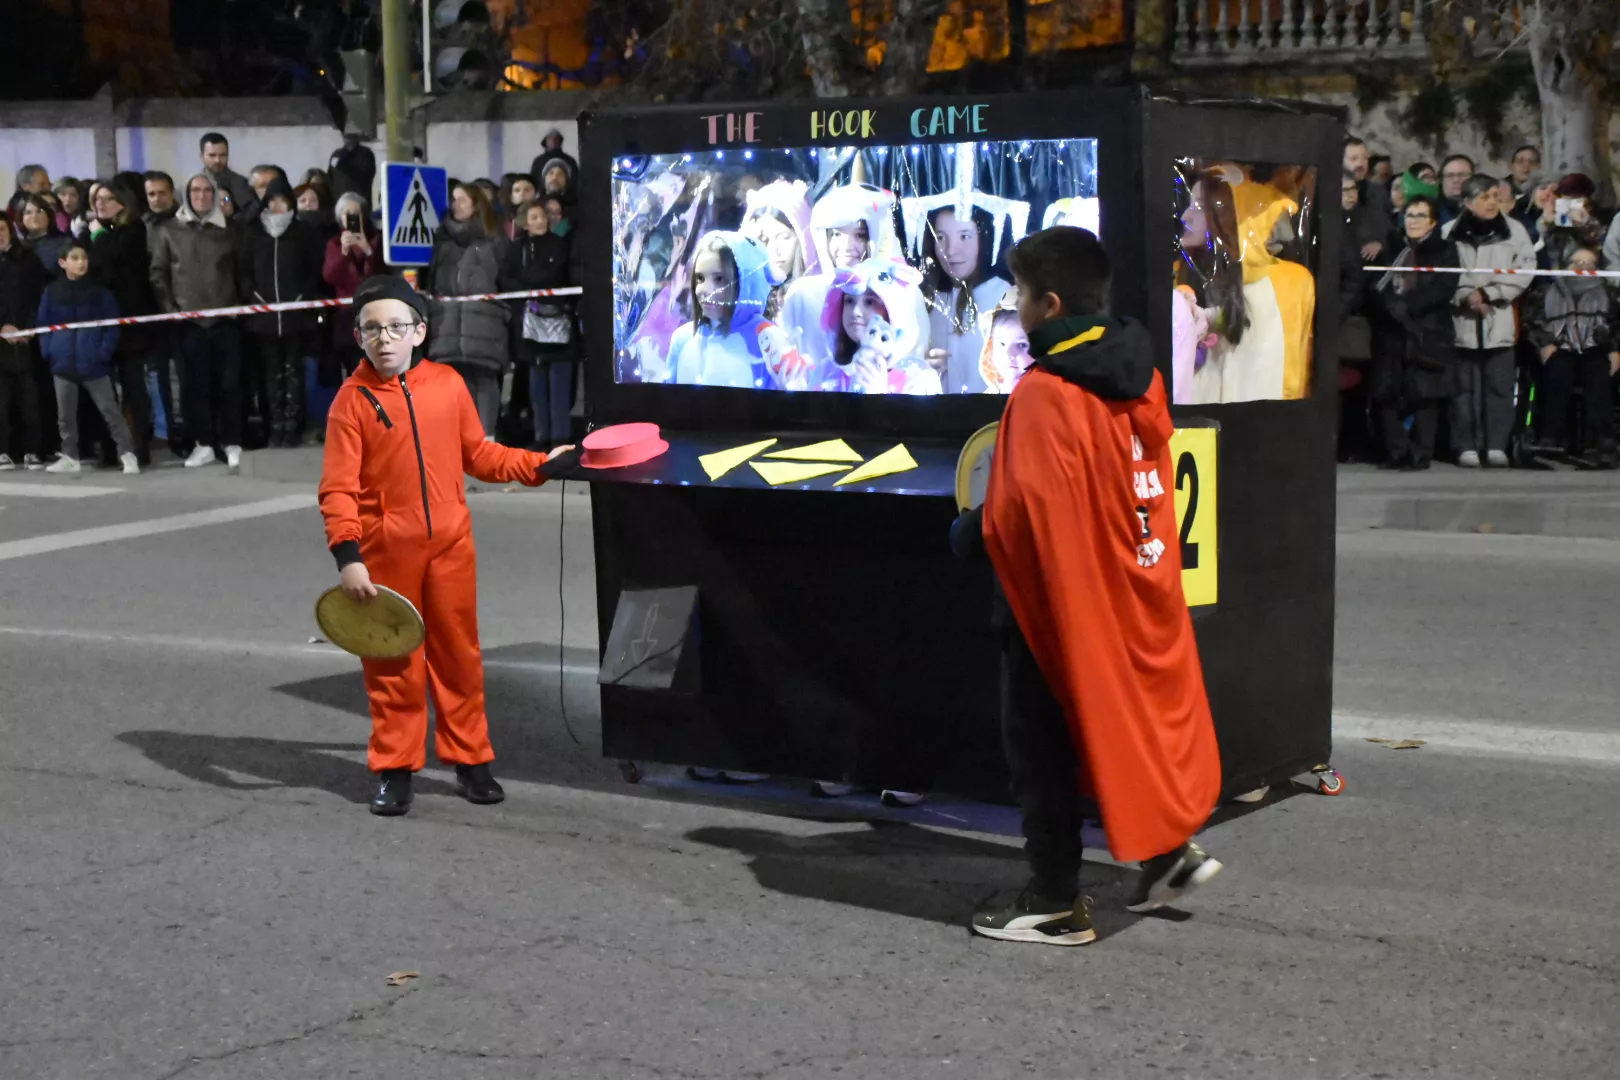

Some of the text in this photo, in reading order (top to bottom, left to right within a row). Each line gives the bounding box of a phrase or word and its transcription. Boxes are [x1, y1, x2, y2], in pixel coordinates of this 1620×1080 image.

[700, 104, 990, 144] THE HOOK GAME
[1175, 451, 1199, 570] 2
